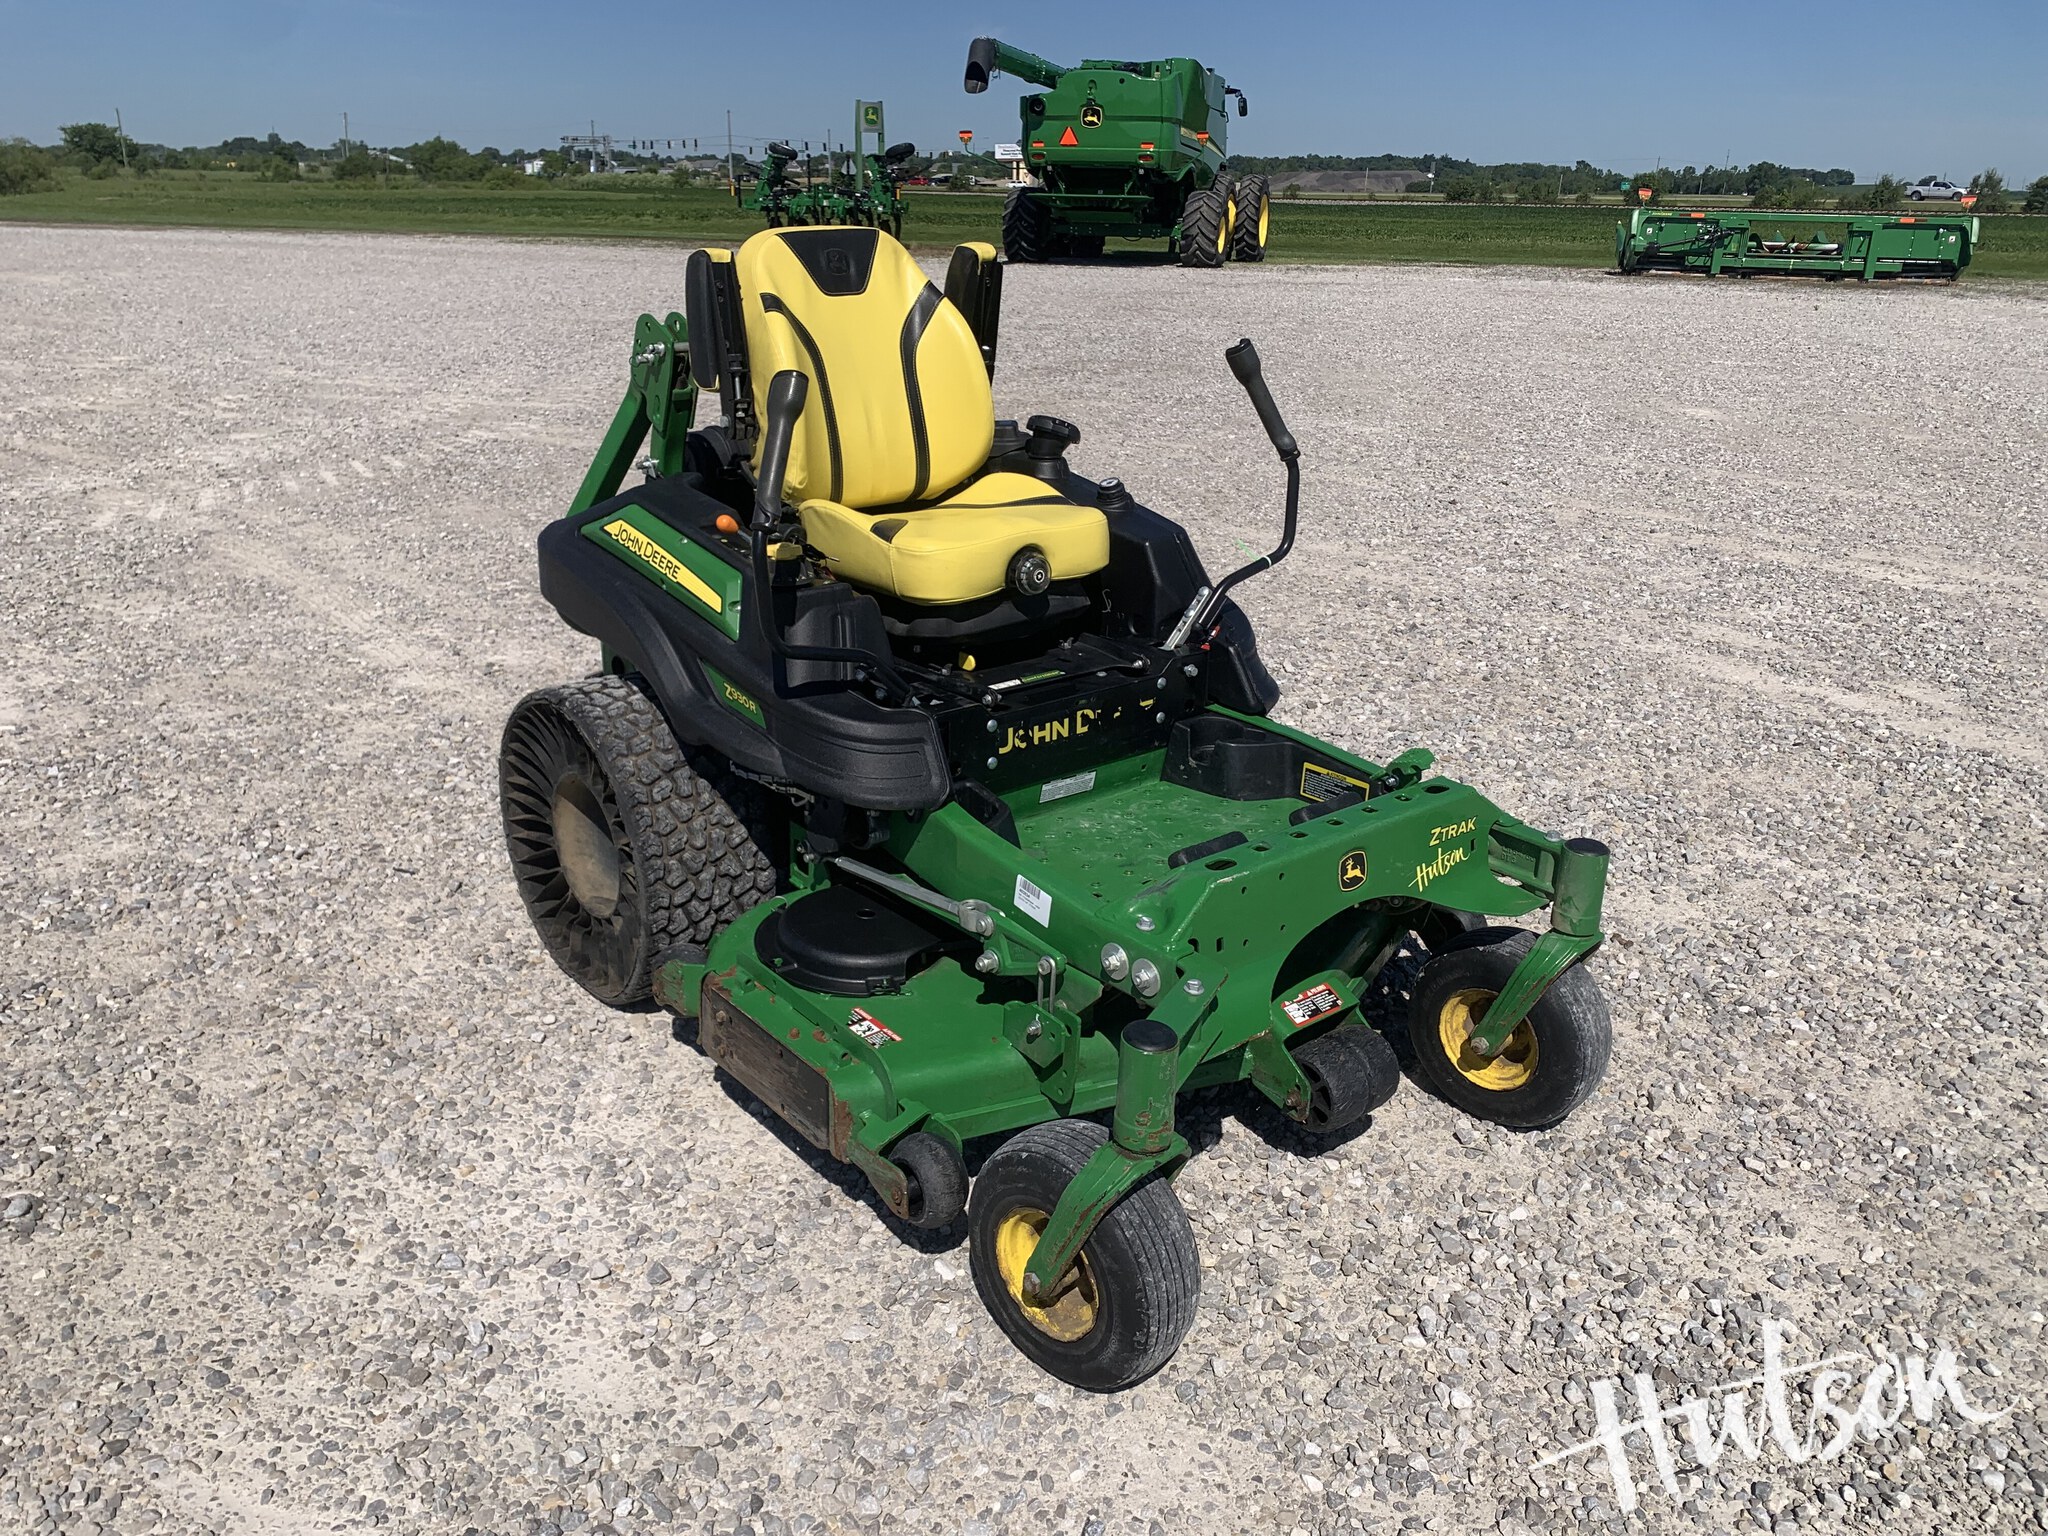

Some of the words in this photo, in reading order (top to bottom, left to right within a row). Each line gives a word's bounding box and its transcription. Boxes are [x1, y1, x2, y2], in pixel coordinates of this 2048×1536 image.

[613, 523, 643, 557] JOHN
[643, 541, 681, 580] DEERE
[723, 682, 757, 714] Z930R
[1429, 816, 1477, 847] ZTRAK
[1408, 847, 1470, 892] Hutson
